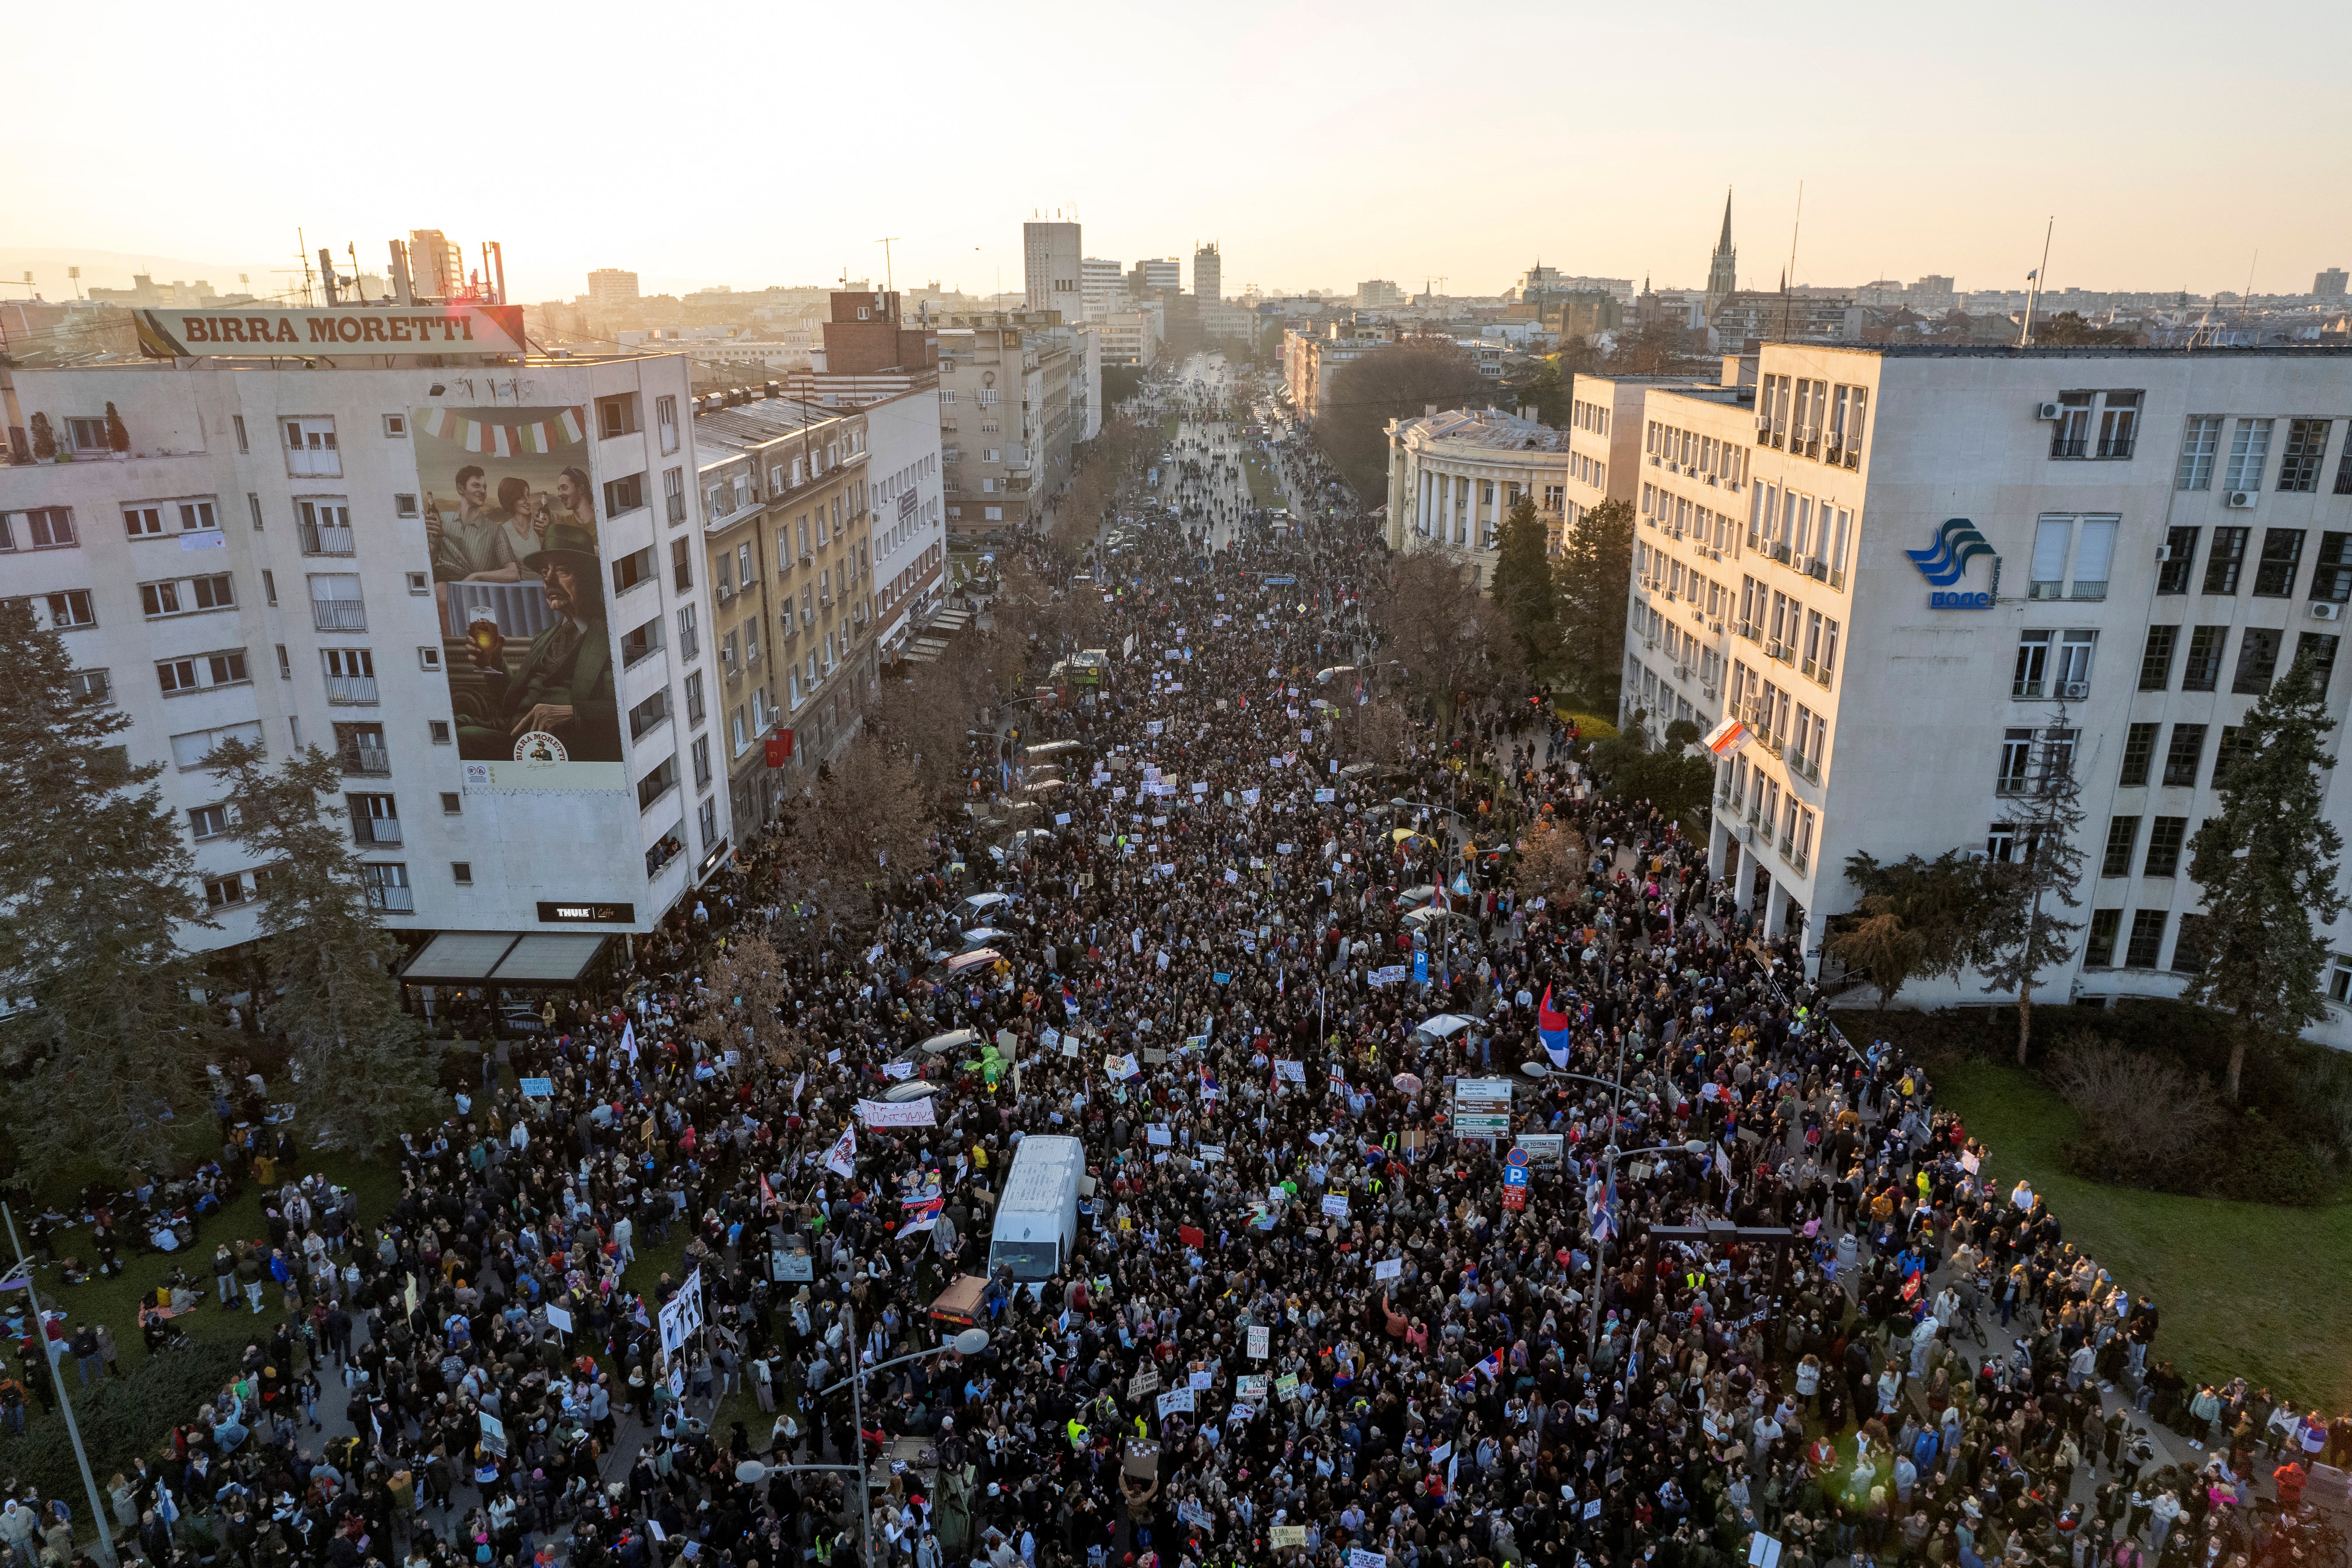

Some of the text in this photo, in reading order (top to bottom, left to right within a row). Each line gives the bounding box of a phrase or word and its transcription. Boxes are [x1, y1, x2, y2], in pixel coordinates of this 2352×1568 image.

[182, 316, 473, 342] BIRRA MORETTI
[516, 734, 565, 761] BIRRA MORETTI
[557, 908, 589, 917] THULE
[1417, 953, 1425, 964] P
[508, 1020, 543, 1031] THULE
[1109, 1056, 1125, 1065] ЗЛАТНО
[1510, 1169, 1522, 1182] P
[1249, 1342, 1265, 1355] МИ
[1131, 1373, 1157, 1387] LE MONDE
